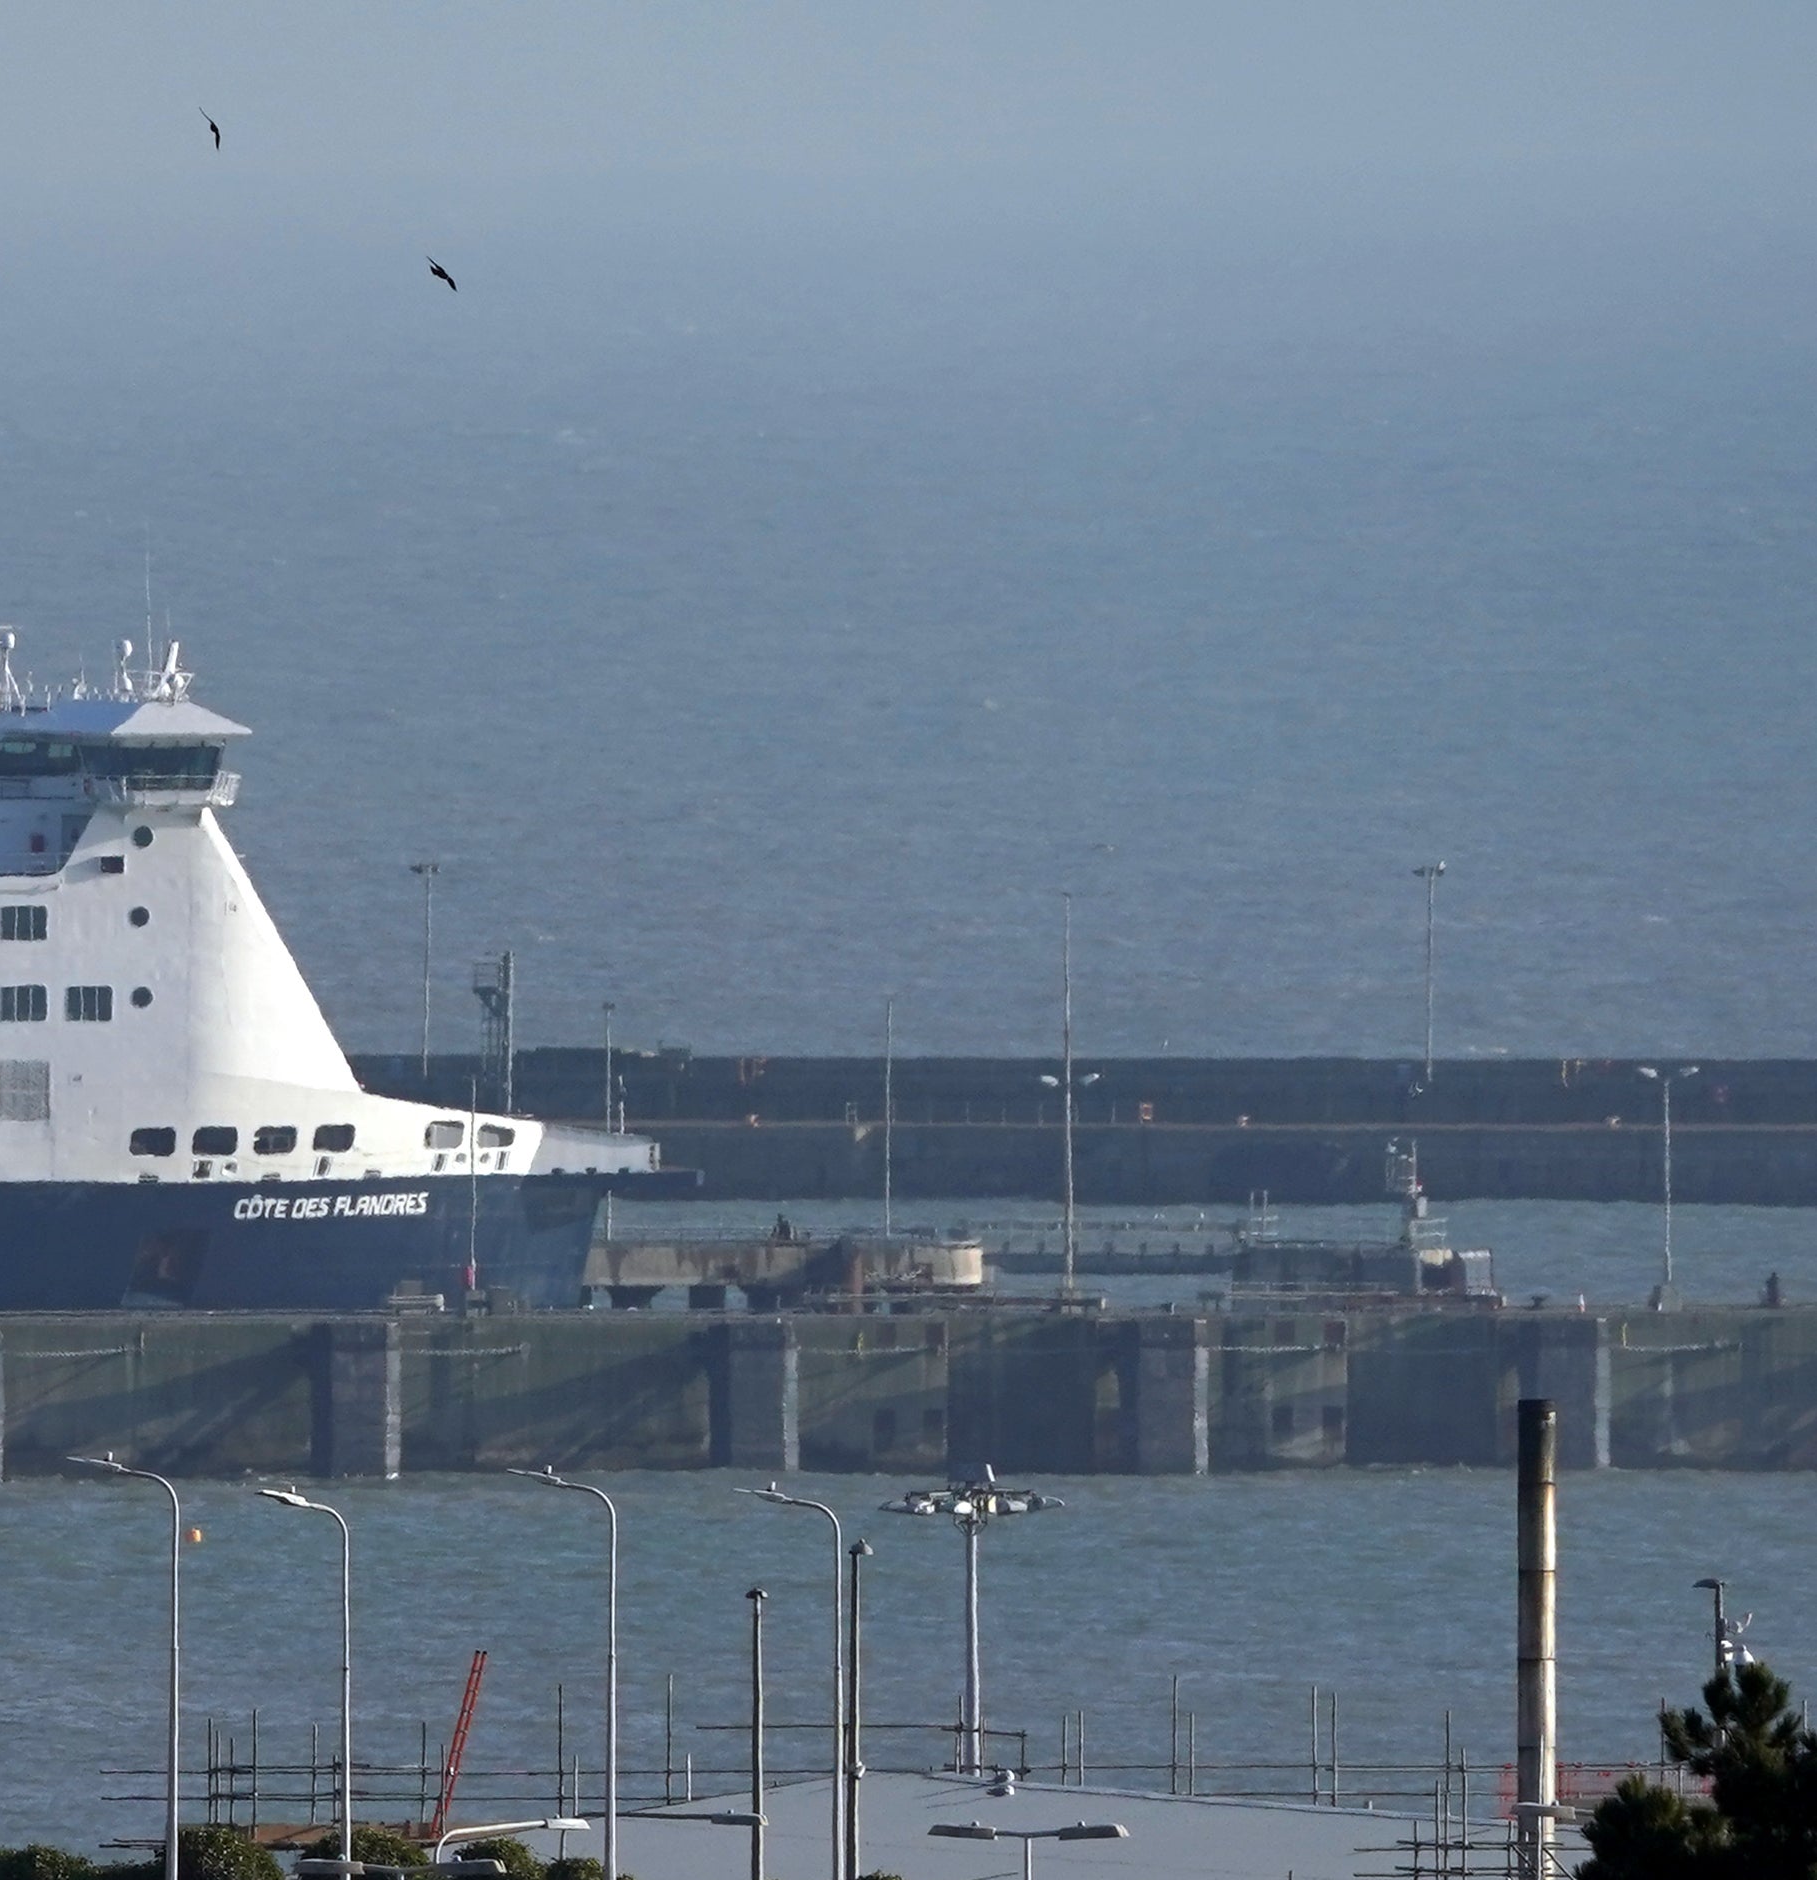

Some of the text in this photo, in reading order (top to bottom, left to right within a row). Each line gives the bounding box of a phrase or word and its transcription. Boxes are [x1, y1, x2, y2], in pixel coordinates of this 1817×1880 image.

[234, 1192, 429, 1220] CÔTE DES FLANDRES
